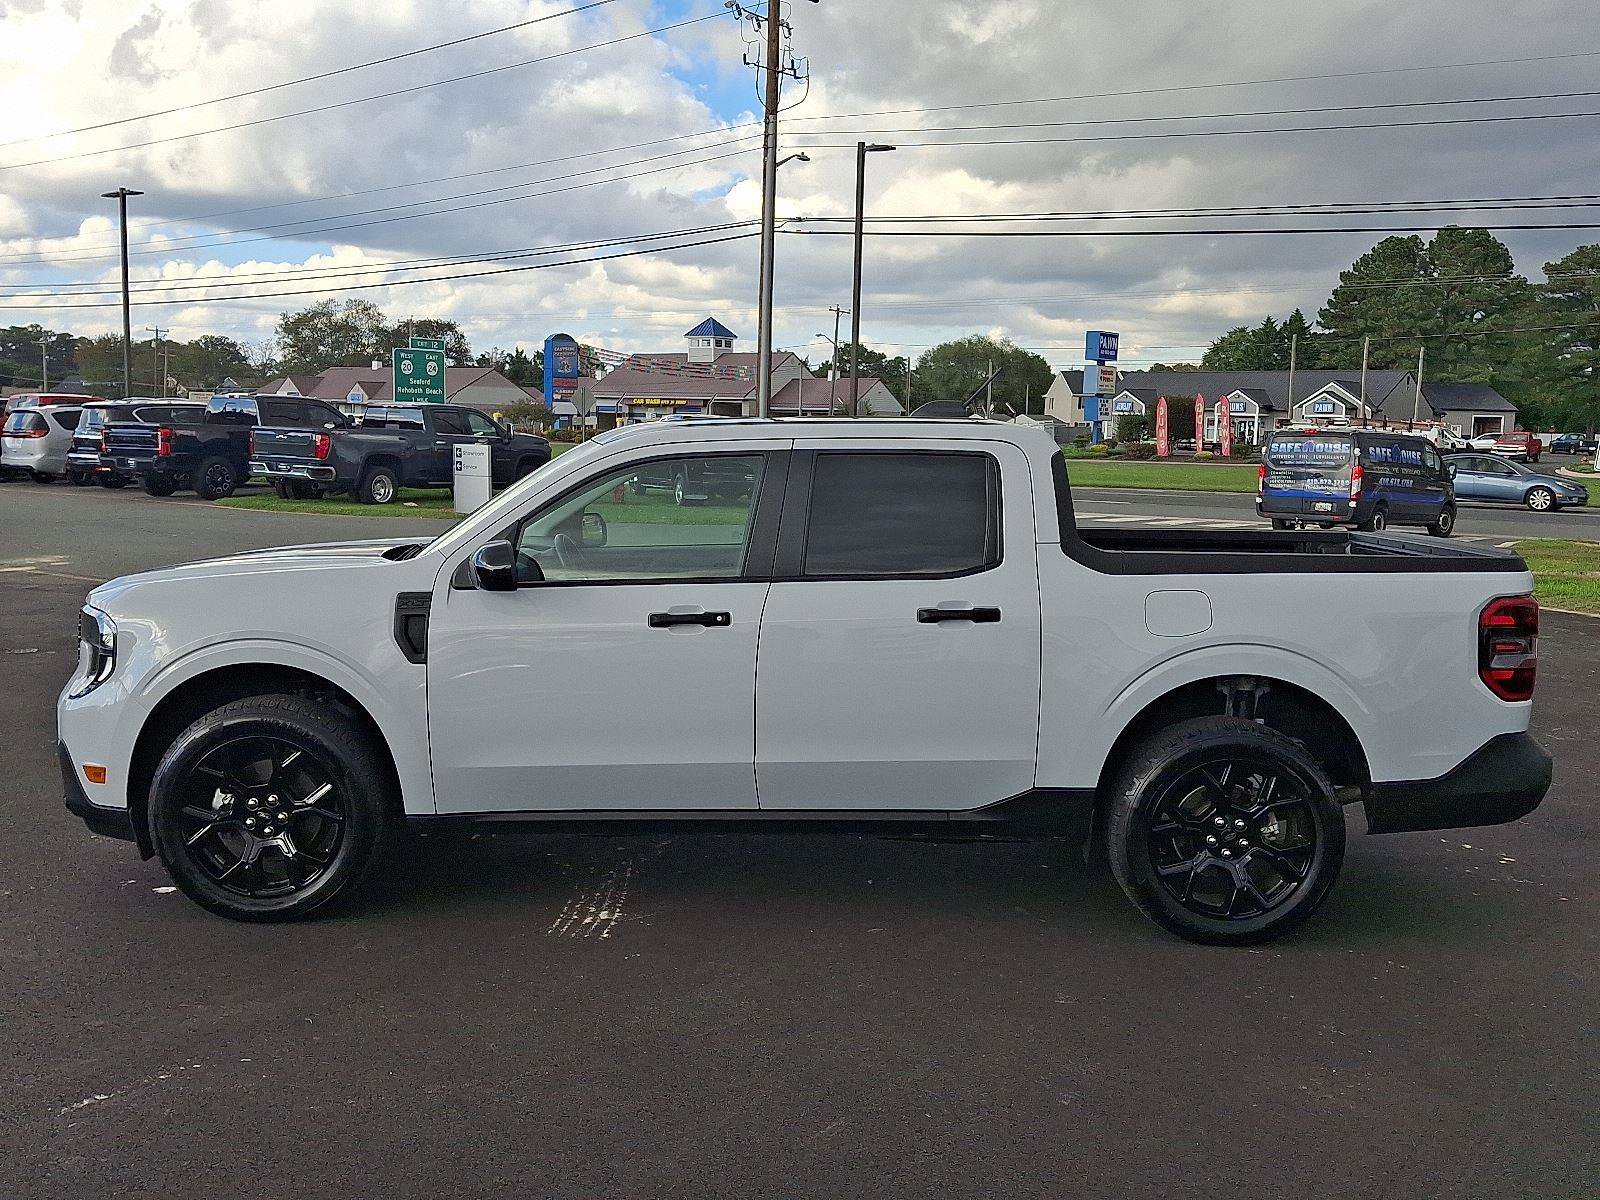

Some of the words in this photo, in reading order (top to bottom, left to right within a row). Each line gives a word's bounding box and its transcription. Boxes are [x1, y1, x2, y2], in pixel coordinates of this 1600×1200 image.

[1099, 335, 1118, 350] PAWN
[402, 363, 412, 372] 20
[427, 364, 437, 373] 24
[397, 386, 424, 394] Rehoboth
[425, 387, 443, 395] Beach
[1230, 402, 1245, 411] UNS
[1315, 403, 1333, 412] PAWN
